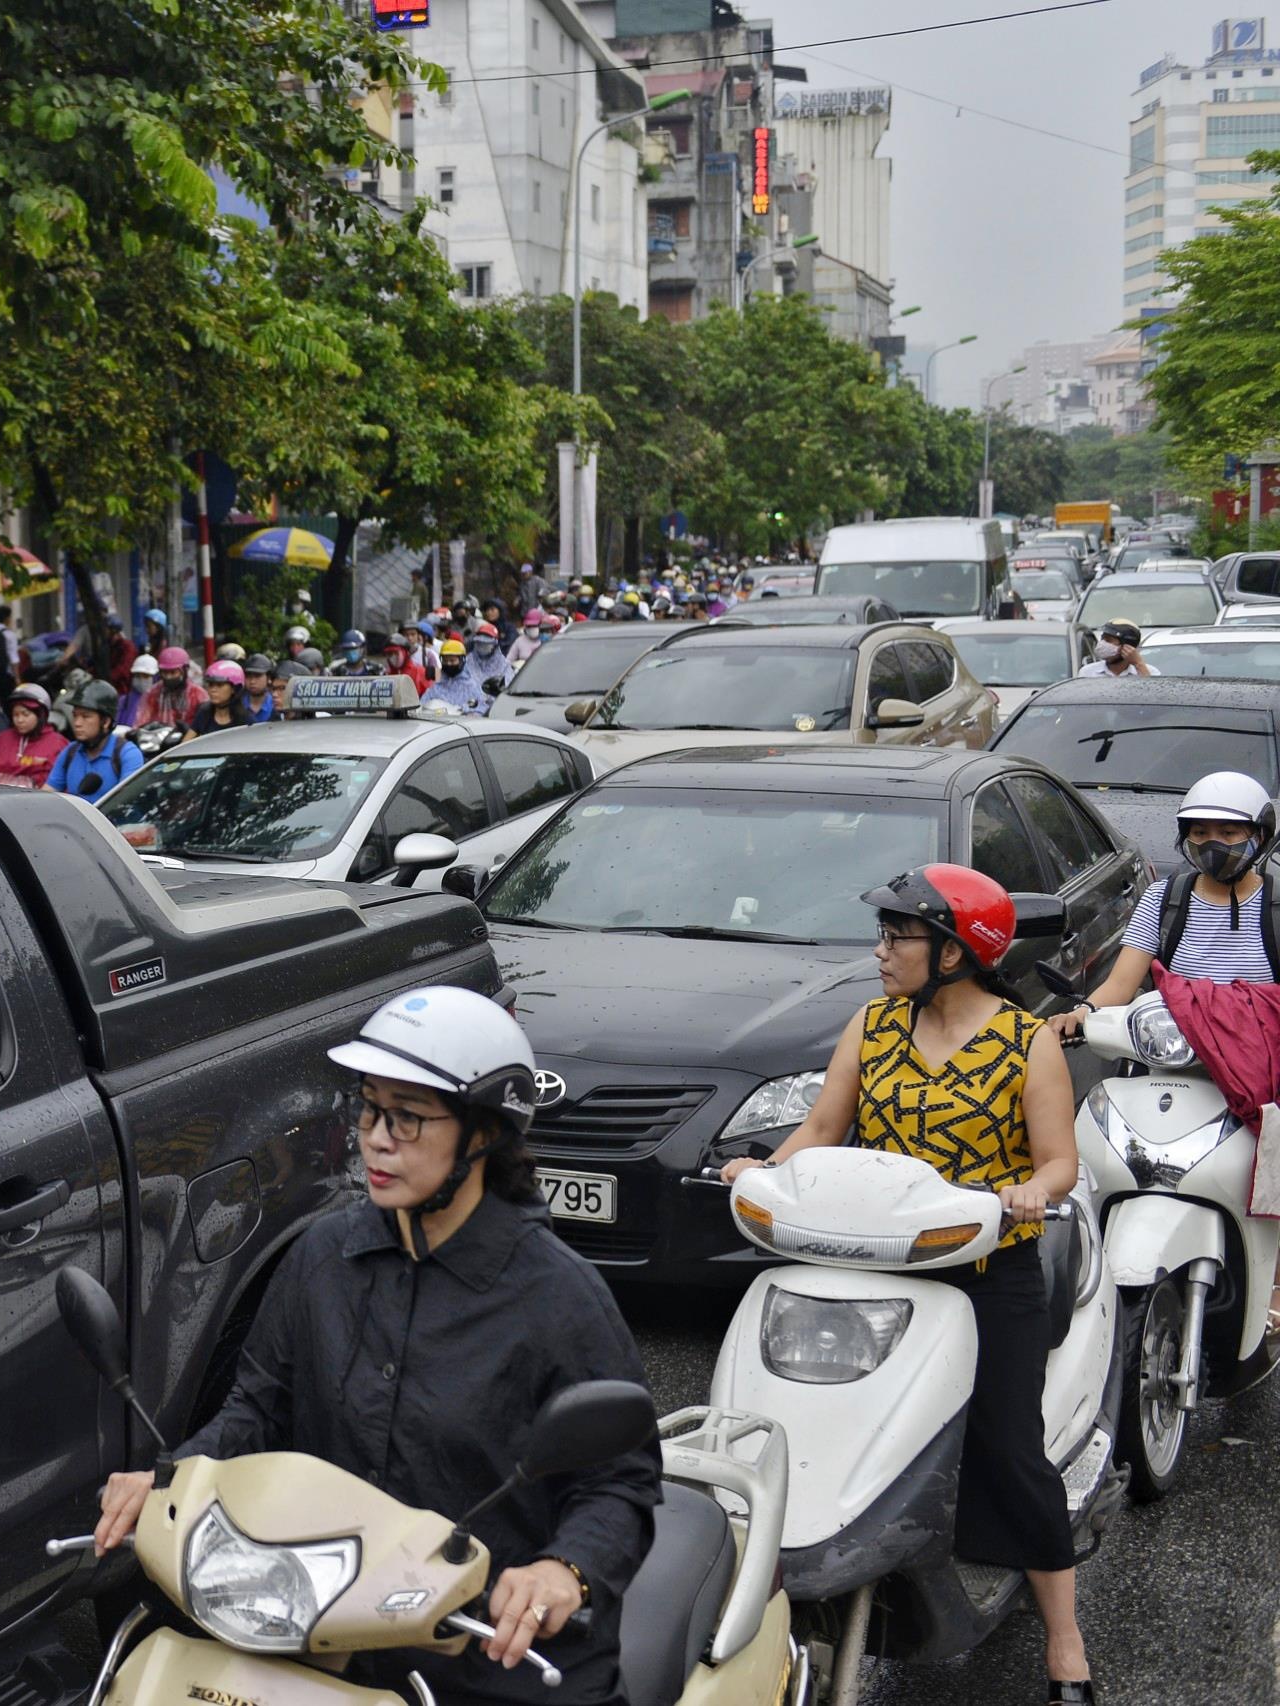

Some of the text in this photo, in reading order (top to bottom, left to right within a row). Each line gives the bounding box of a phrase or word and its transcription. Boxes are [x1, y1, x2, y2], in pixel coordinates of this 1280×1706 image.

[801, 89, 885, 108] SAIGON BANK
[297, 681, 319, 696] SAO
[345, 681, 372, 696] NAM
[117, 966, 162, 988] RANGER
